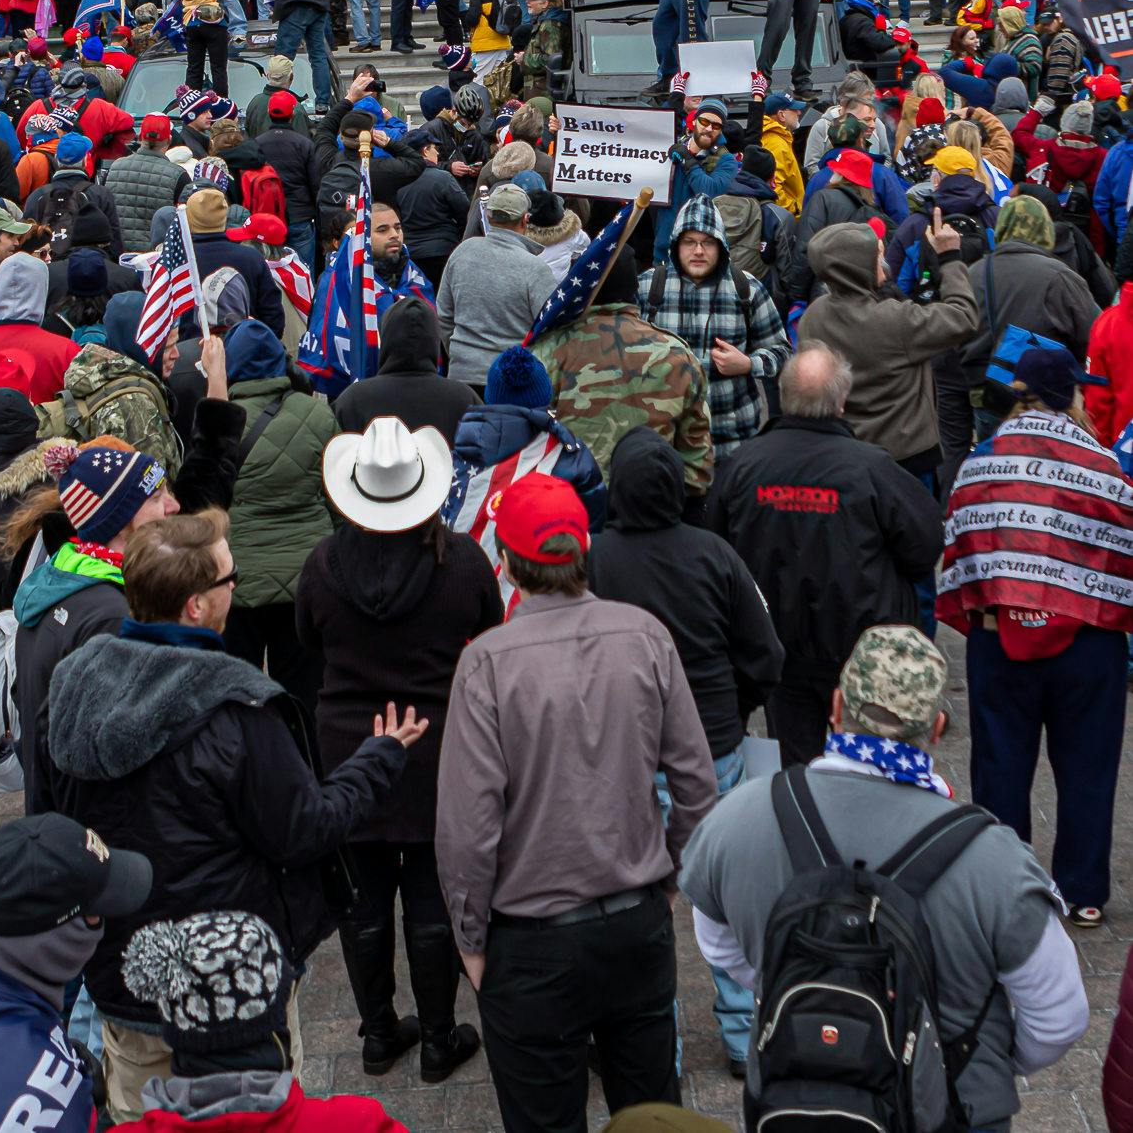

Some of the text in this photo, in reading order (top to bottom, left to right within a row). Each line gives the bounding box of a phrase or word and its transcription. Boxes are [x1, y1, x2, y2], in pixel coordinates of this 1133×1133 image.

[556, 163, 632, 184] Matters
[1048, 466, 1103, 491] status
[1108, 484, 1127, 502] of
[1019, 509, 1038, 524] to
[1043, 514, 1093, 538] abuse
[1084, 572, 1133, 600] George
